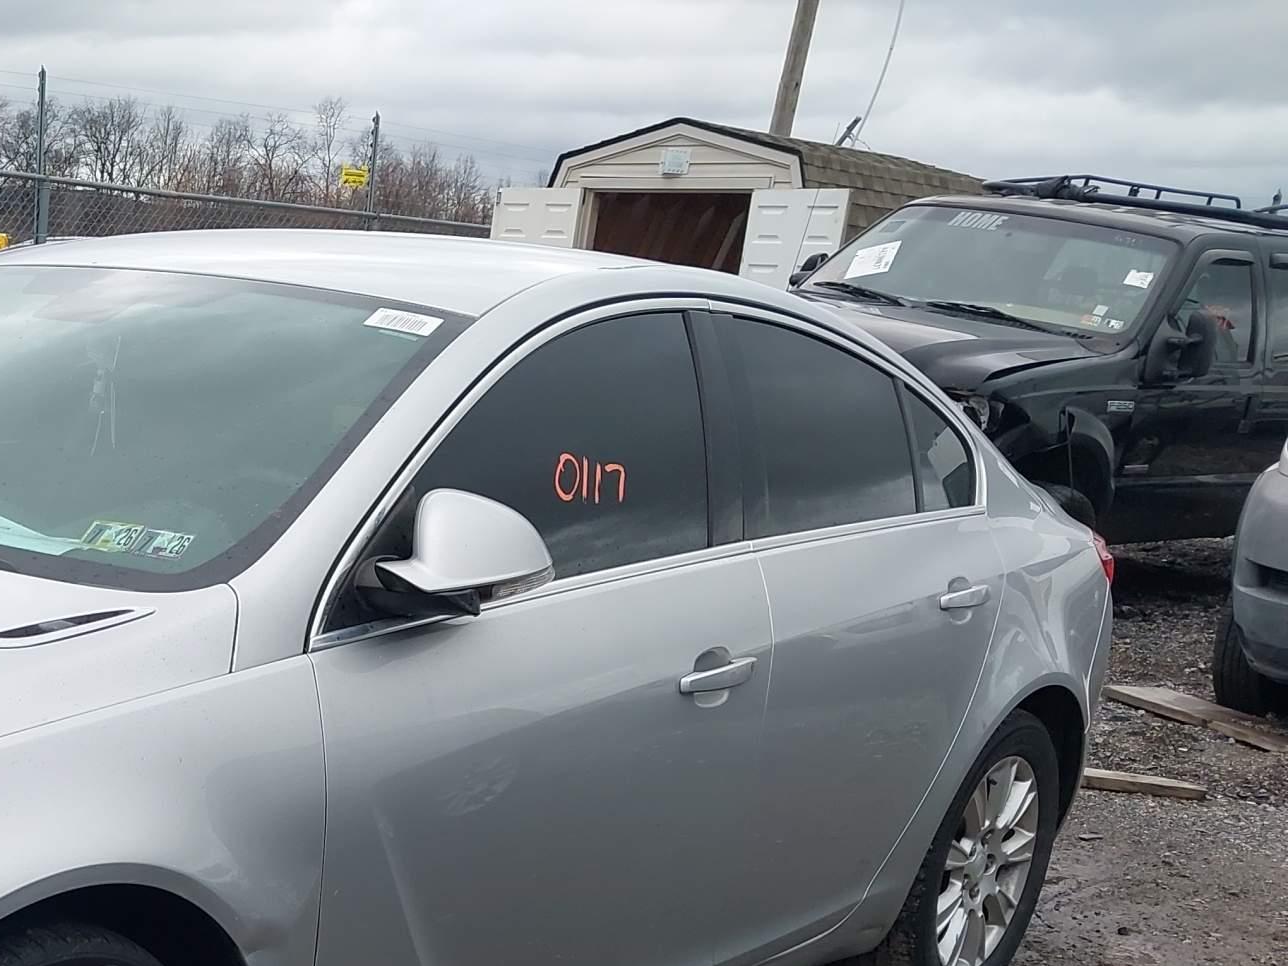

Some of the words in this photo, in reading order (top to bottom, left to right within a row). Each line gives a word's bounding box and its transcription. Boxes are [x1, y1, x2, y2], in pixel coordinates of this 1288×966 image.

[948, 211, 1009, 231] HOME
[554, 453, 626, 504] 0117
[116, 527, 139, 547] 26
[169, 535, 191, 555] 26
